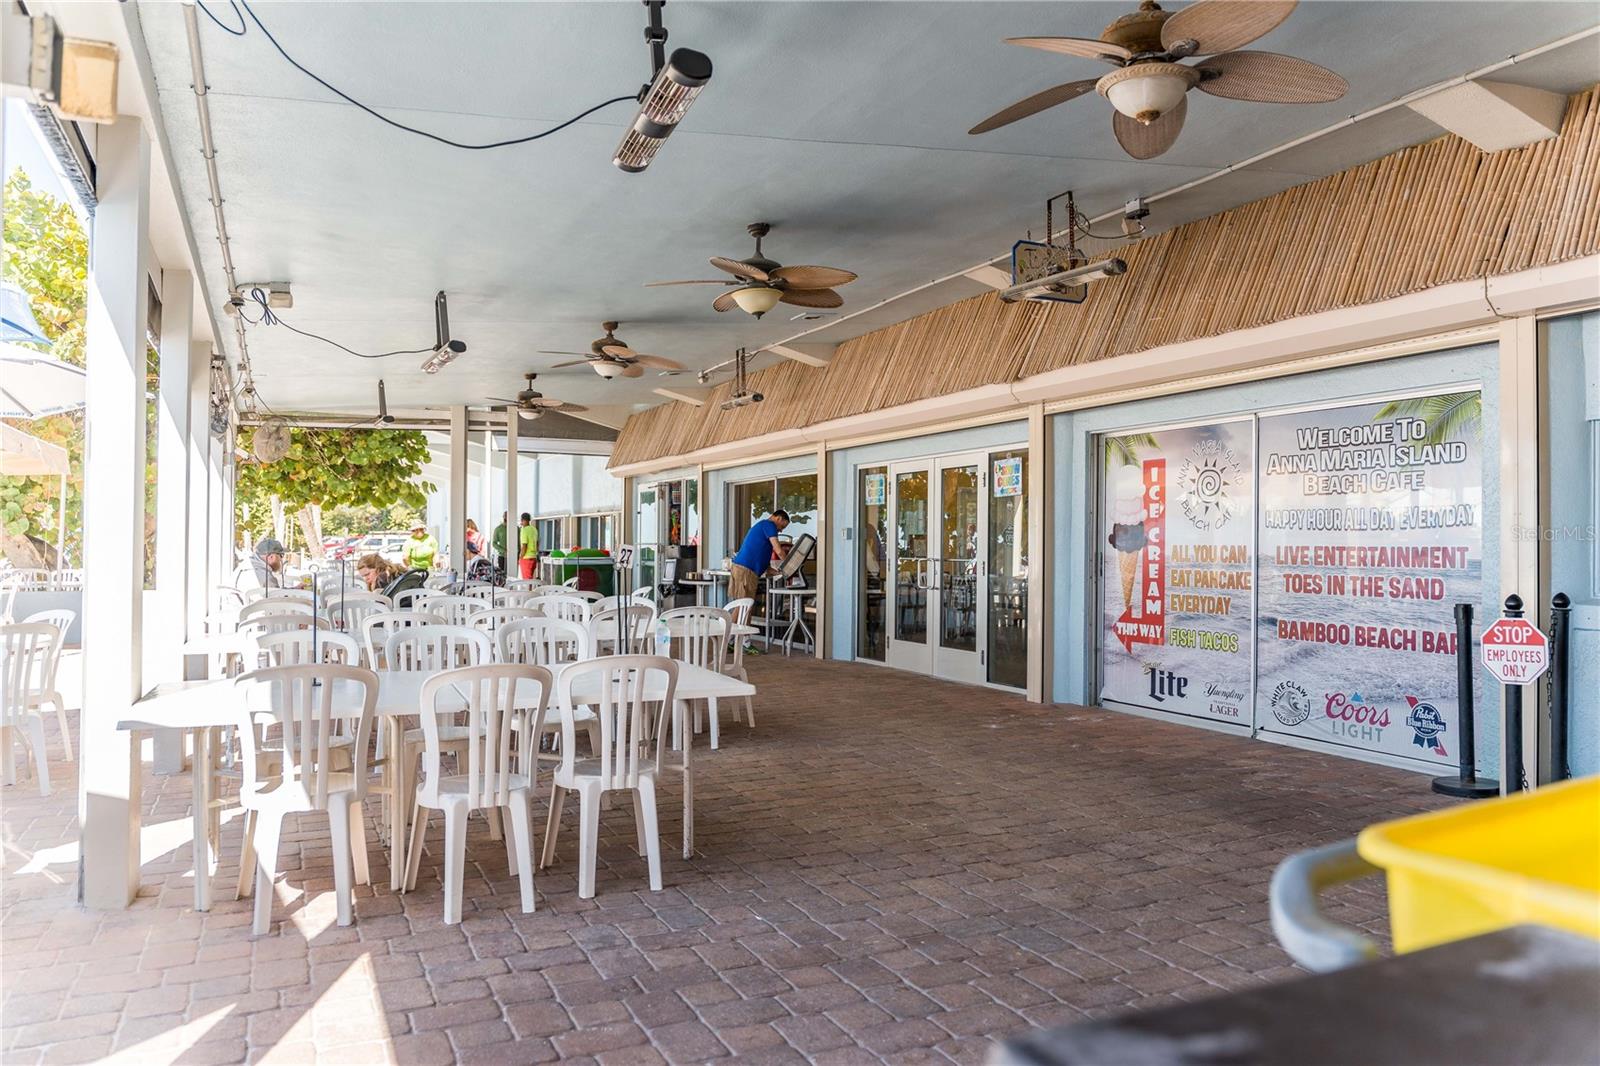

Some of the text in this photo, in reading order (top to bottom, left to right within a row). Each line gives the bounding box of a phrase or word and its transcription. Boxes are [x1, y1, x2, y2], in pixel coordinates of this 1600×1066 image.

[1297, 417, 1427, 450] WELCOME TO
[1266, 442, 1466, 475] ANNA MARIA ISLAND
[1303, 469, 1425, 495] BEACH CAFE
[1265, 504, 1474, 531] HAPPY HOUR ALL DAY EVERYDAY
[620, 548, 633, 564] 27
[1171, 544, 1247, 563] ALL YOU CAN
[1276, 546, 1469, 568] LIVE ENTERTAINMENT
[1170, 569, 1252, 590] EAT PANCAKE
[1283, 573, 1445, 601] TOES IN THE SAND
[1170, 593, 1231, 615] EVERYDAY
[1116, 622, 1162, 639] THIS WAY
[1169, 627, 1239, 653] FISH TACOS
[1278, 619, 1350, 646] BAMBOO
[1355, 626, 1417, 651] BEACH
[1493, 626, 1533, 644] STOP
[1487, 649, 1542, 664] EMPLOYEES
[1502, 664, 1527, 678] ONLY
[1149, 667, 1188, 702] Lite
[1204, 682, 1245, 702] Yuengling
[1271, 680, 1308, 707] WHITE CLAW
[1210, 703, 1239, 717] LAGER
[1325, 692, 1391, 727] Coors
[1416, 707, 1436, 720] Pabst
[1332, 720, 1383, 742] LIGHT
[1407, 717, 1422, 728] Blue
[1422, 719, 1445, 732] Ribbon
